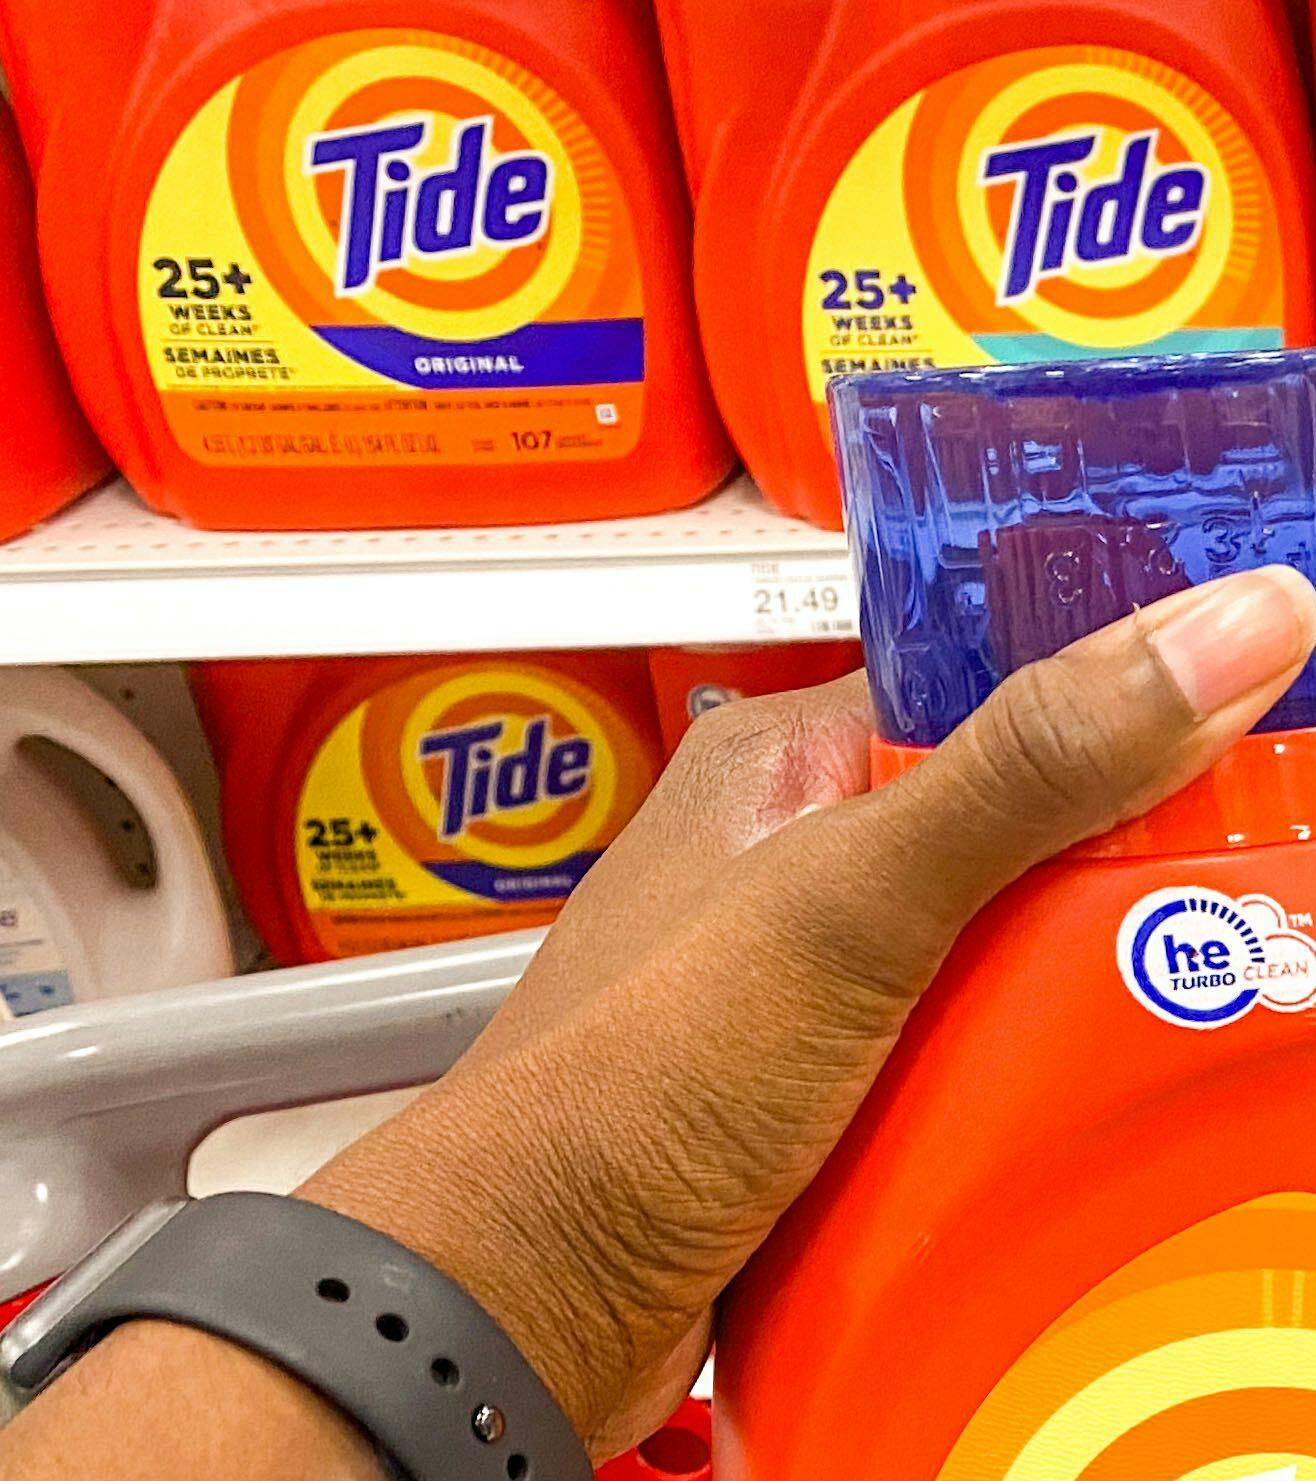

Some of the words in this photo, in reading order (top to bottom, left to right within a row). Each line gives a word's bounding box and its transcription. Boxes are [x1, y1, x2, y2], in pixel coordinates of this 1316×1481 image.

[306, 118, 551, 294] Tide
[981, 130, 1205, 305] Tide
[153, 258, 252, 299] 25+
[820, 269, 916, 310] 25+
[169, 304, 252, 321] WEEKS
[832, 315, 912, 331] WEEKS
[163, 347, 280, 364] SEMAINES
[414, 355, 524, 375] ORIGINAL
[511, 431, 552, 451] 107
[755, 588, 838, 614] 21.49
[421, 718, 592, 837] Tide
[305, 817, 377, 847] 25+
[1163, 934, 1230, 974] he
[1170, 973, 1236, 990] TURBO
[1243, 961, 1308, 981] CLEAN
